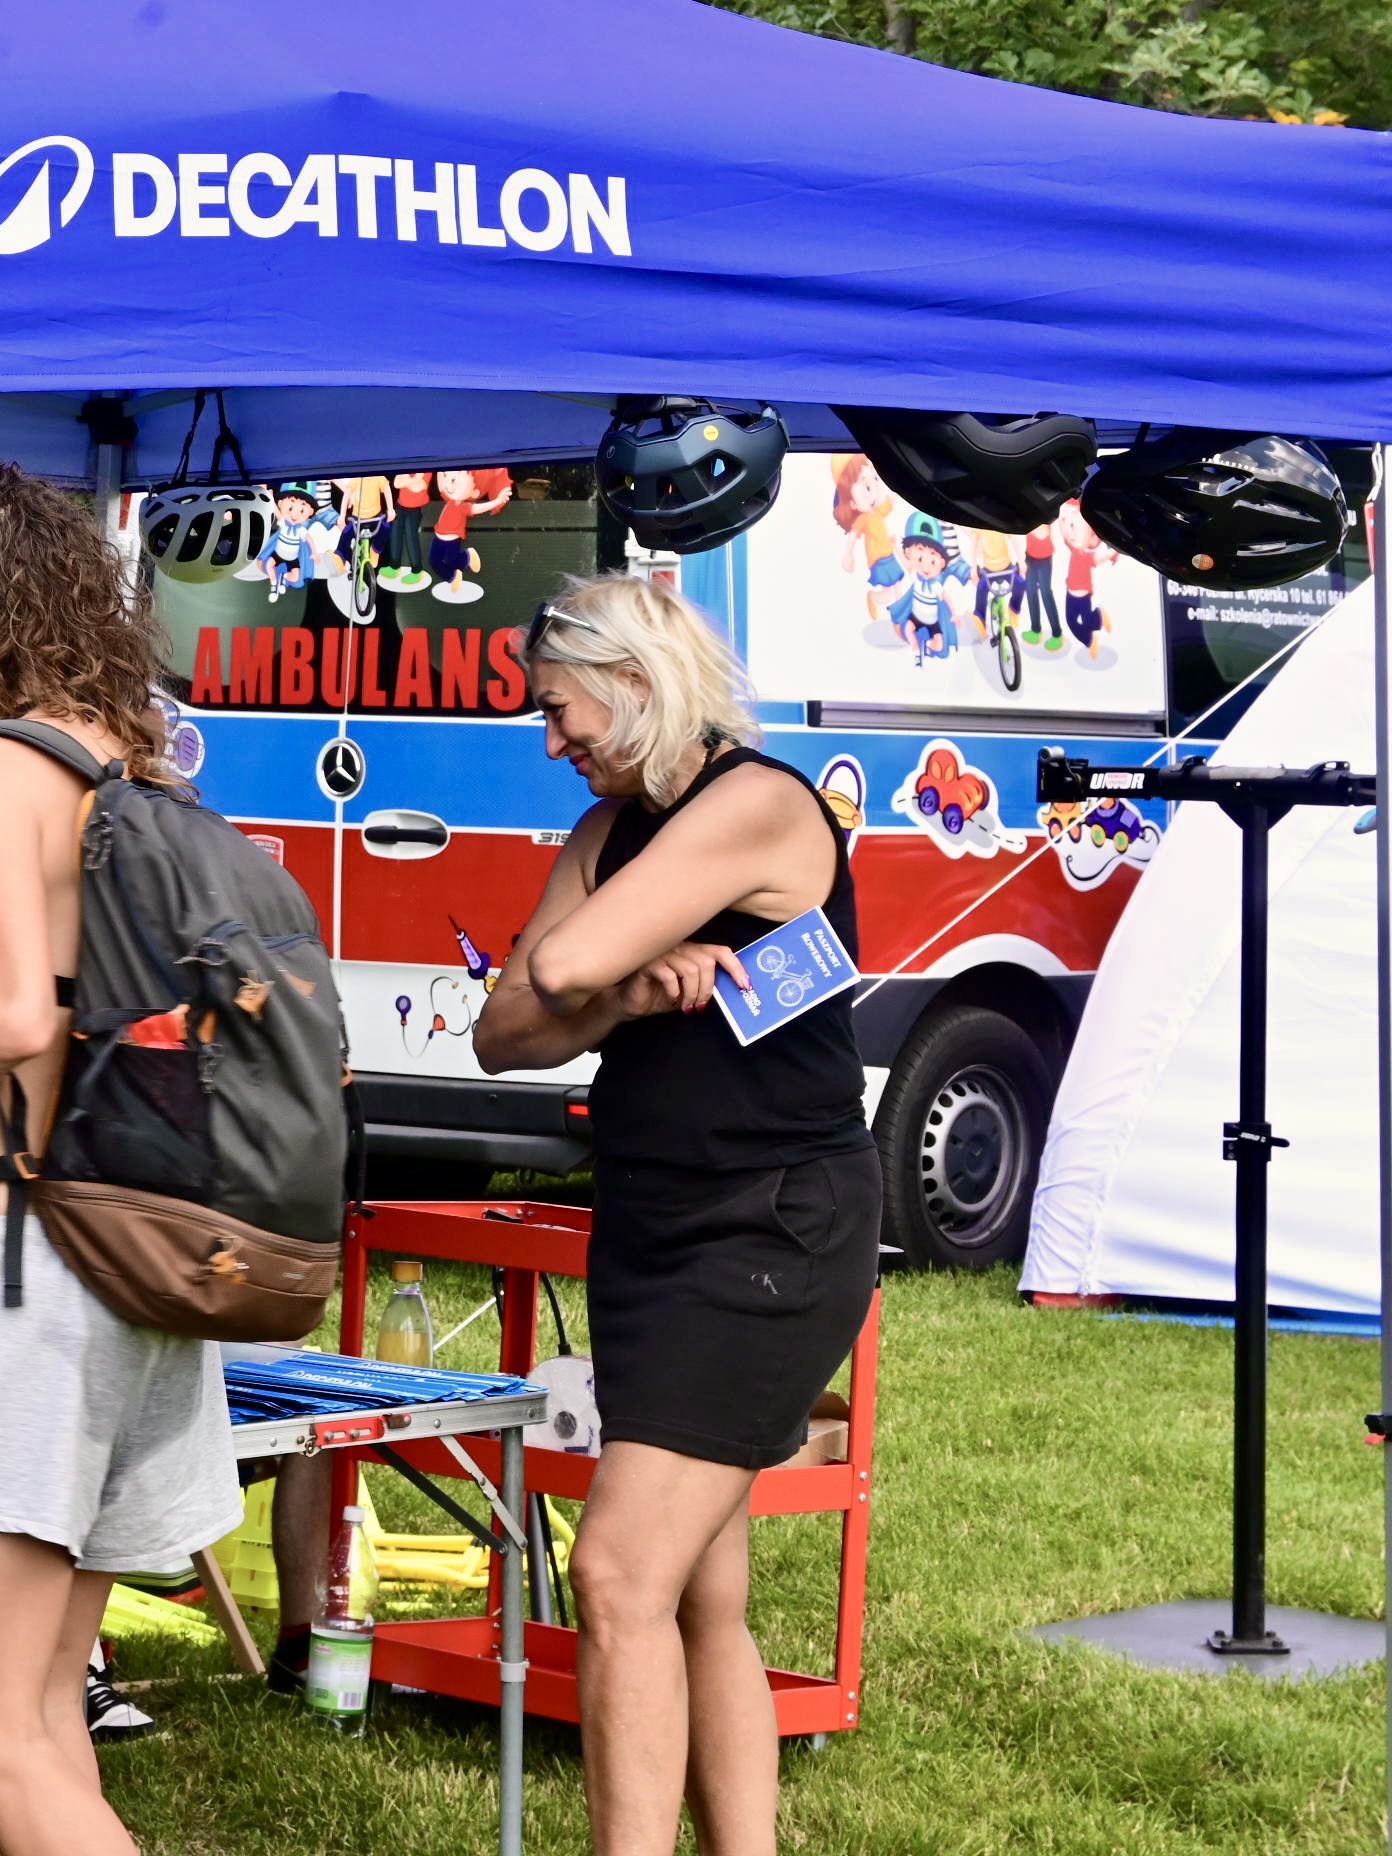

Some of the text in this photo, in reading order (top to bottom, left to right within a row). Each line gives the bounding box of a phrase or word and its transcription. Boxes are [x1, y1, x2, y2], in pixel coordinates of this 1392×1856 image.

[112, 152, 633, 256] DECATHLON
[191, 626, 526, 711] AMBULANS
[801, 932, 832, 978] ROWEROWY
[814, 929, 842, 968] PASZPORT
[749, 986, 762, 1007] ADIO
